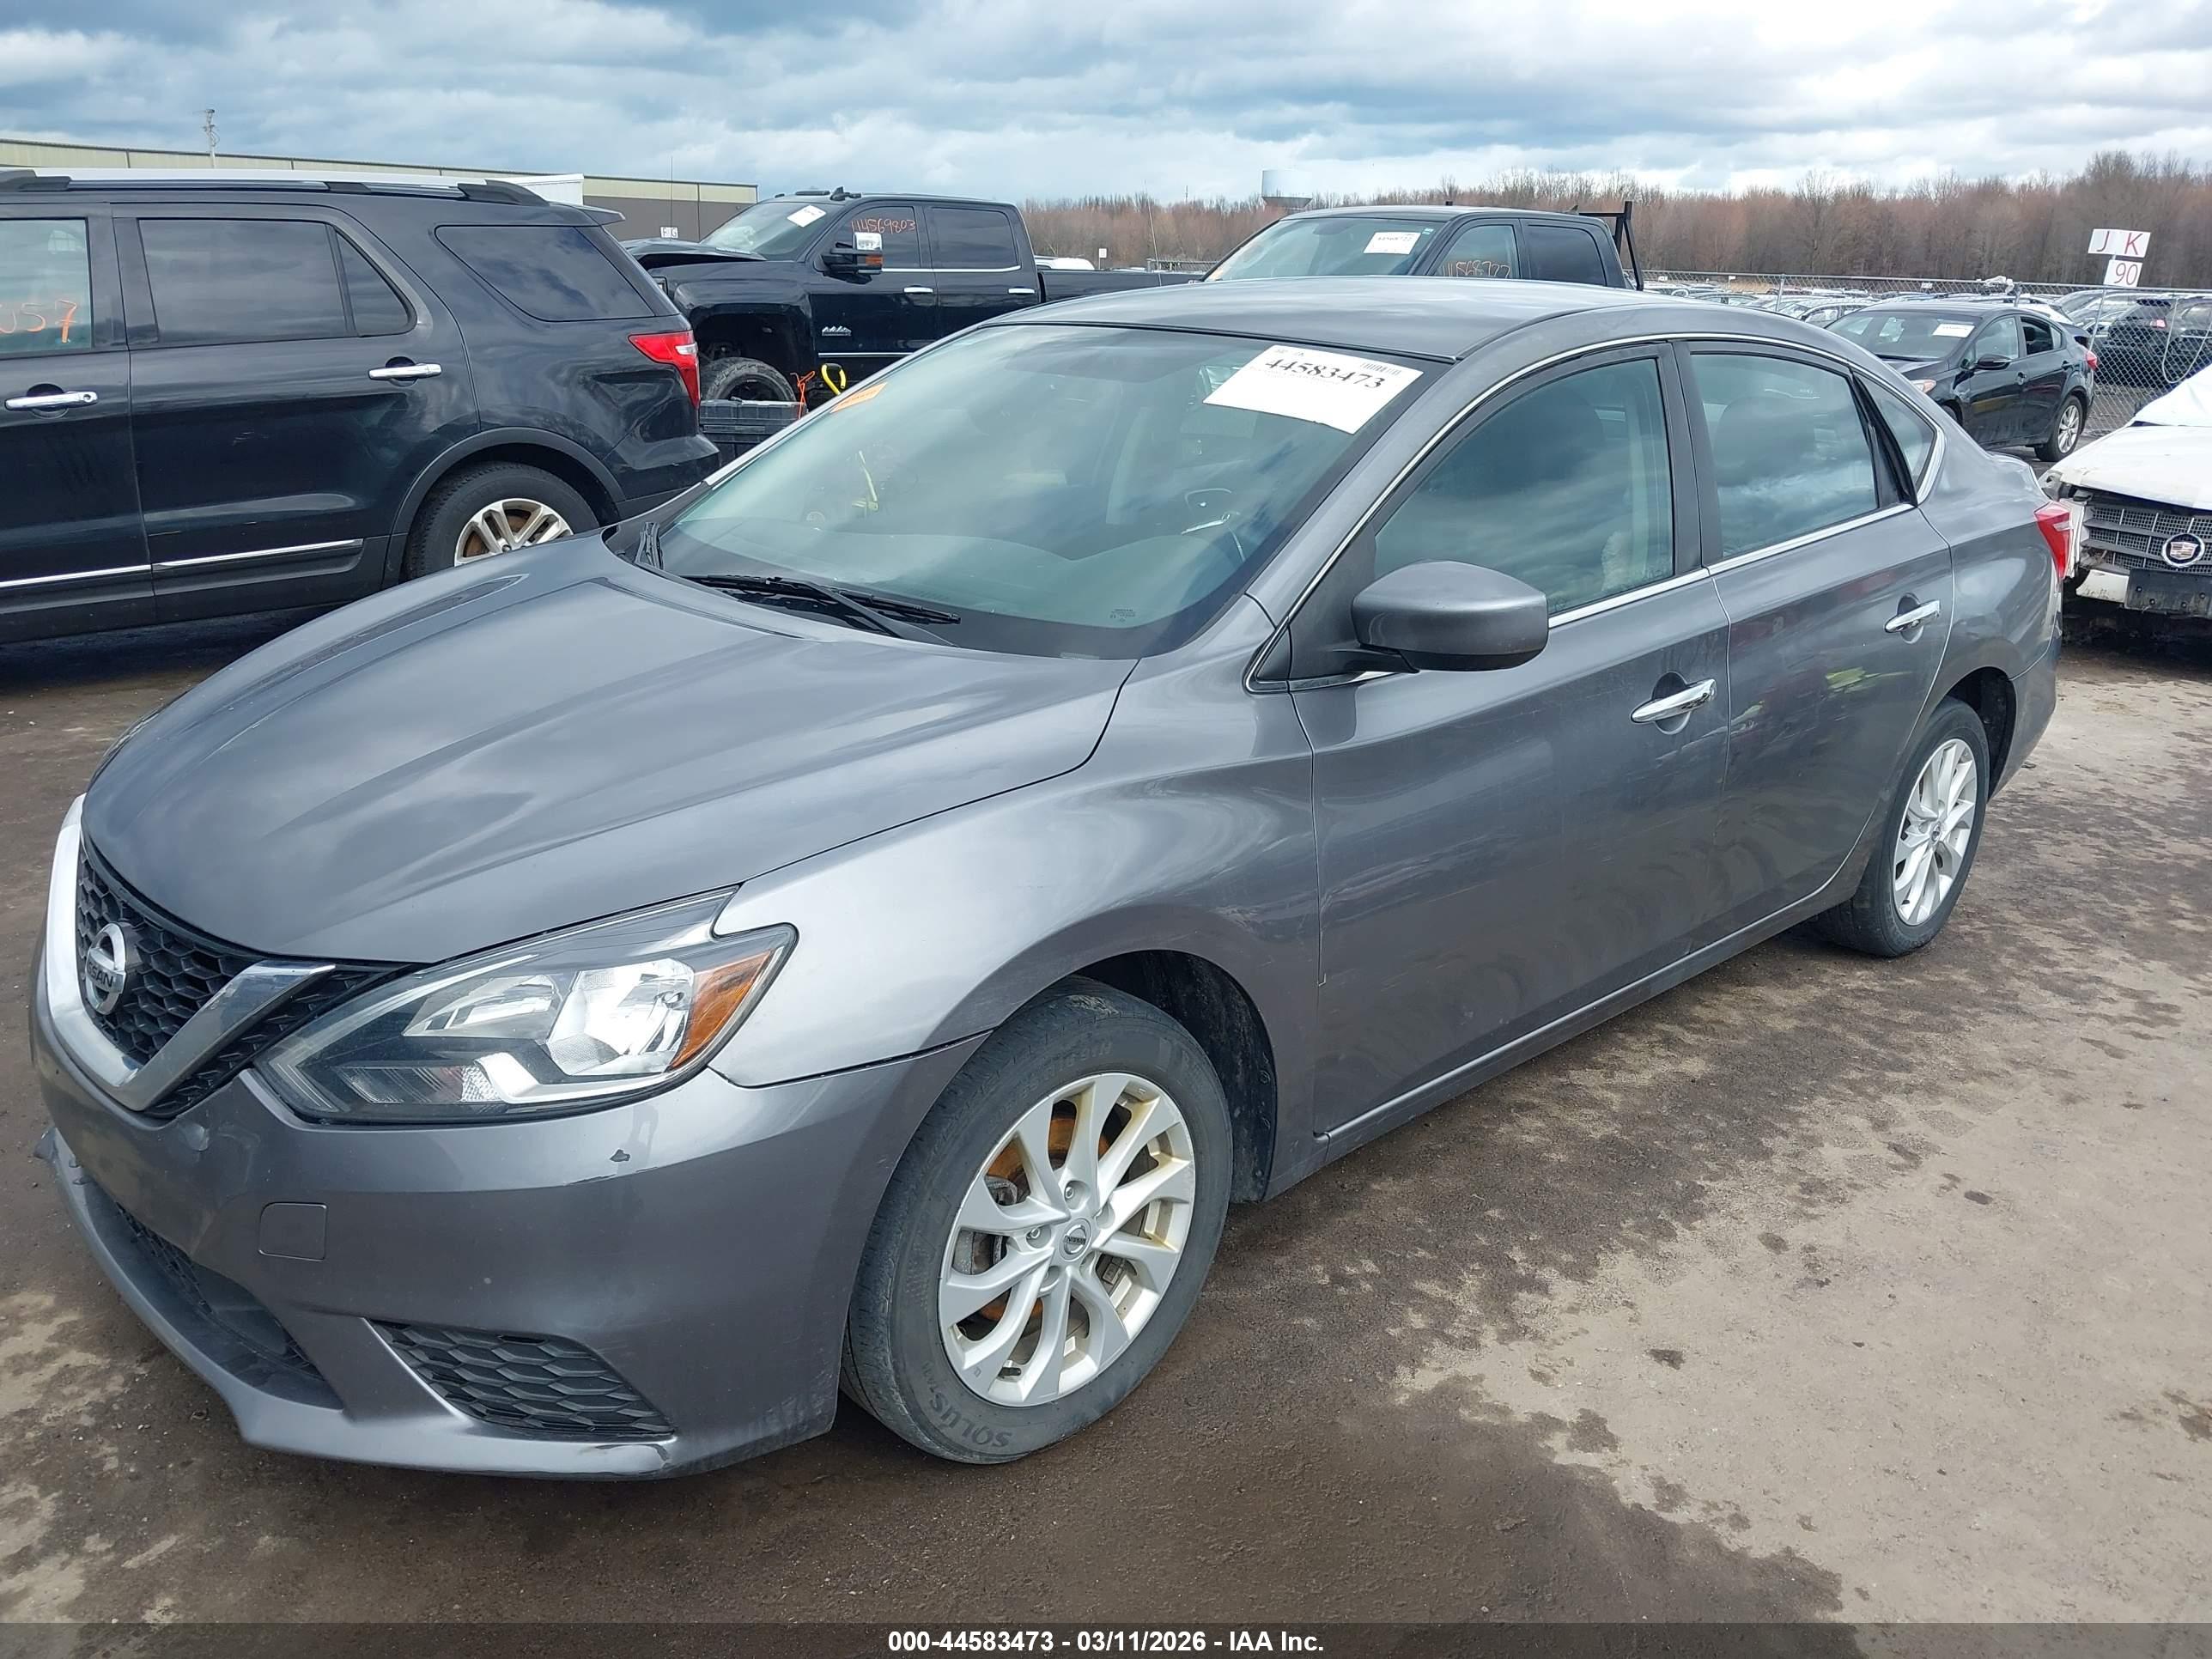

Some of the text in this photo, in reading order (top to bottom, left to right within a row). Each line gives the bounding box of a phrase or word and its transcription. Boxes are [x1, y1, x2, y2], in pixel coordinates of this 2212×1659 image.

[2096, 231, 2142, 255] J K
[2113, 263, 2138, 286] 90
[1265, 359, 1386, 389] 44583473
